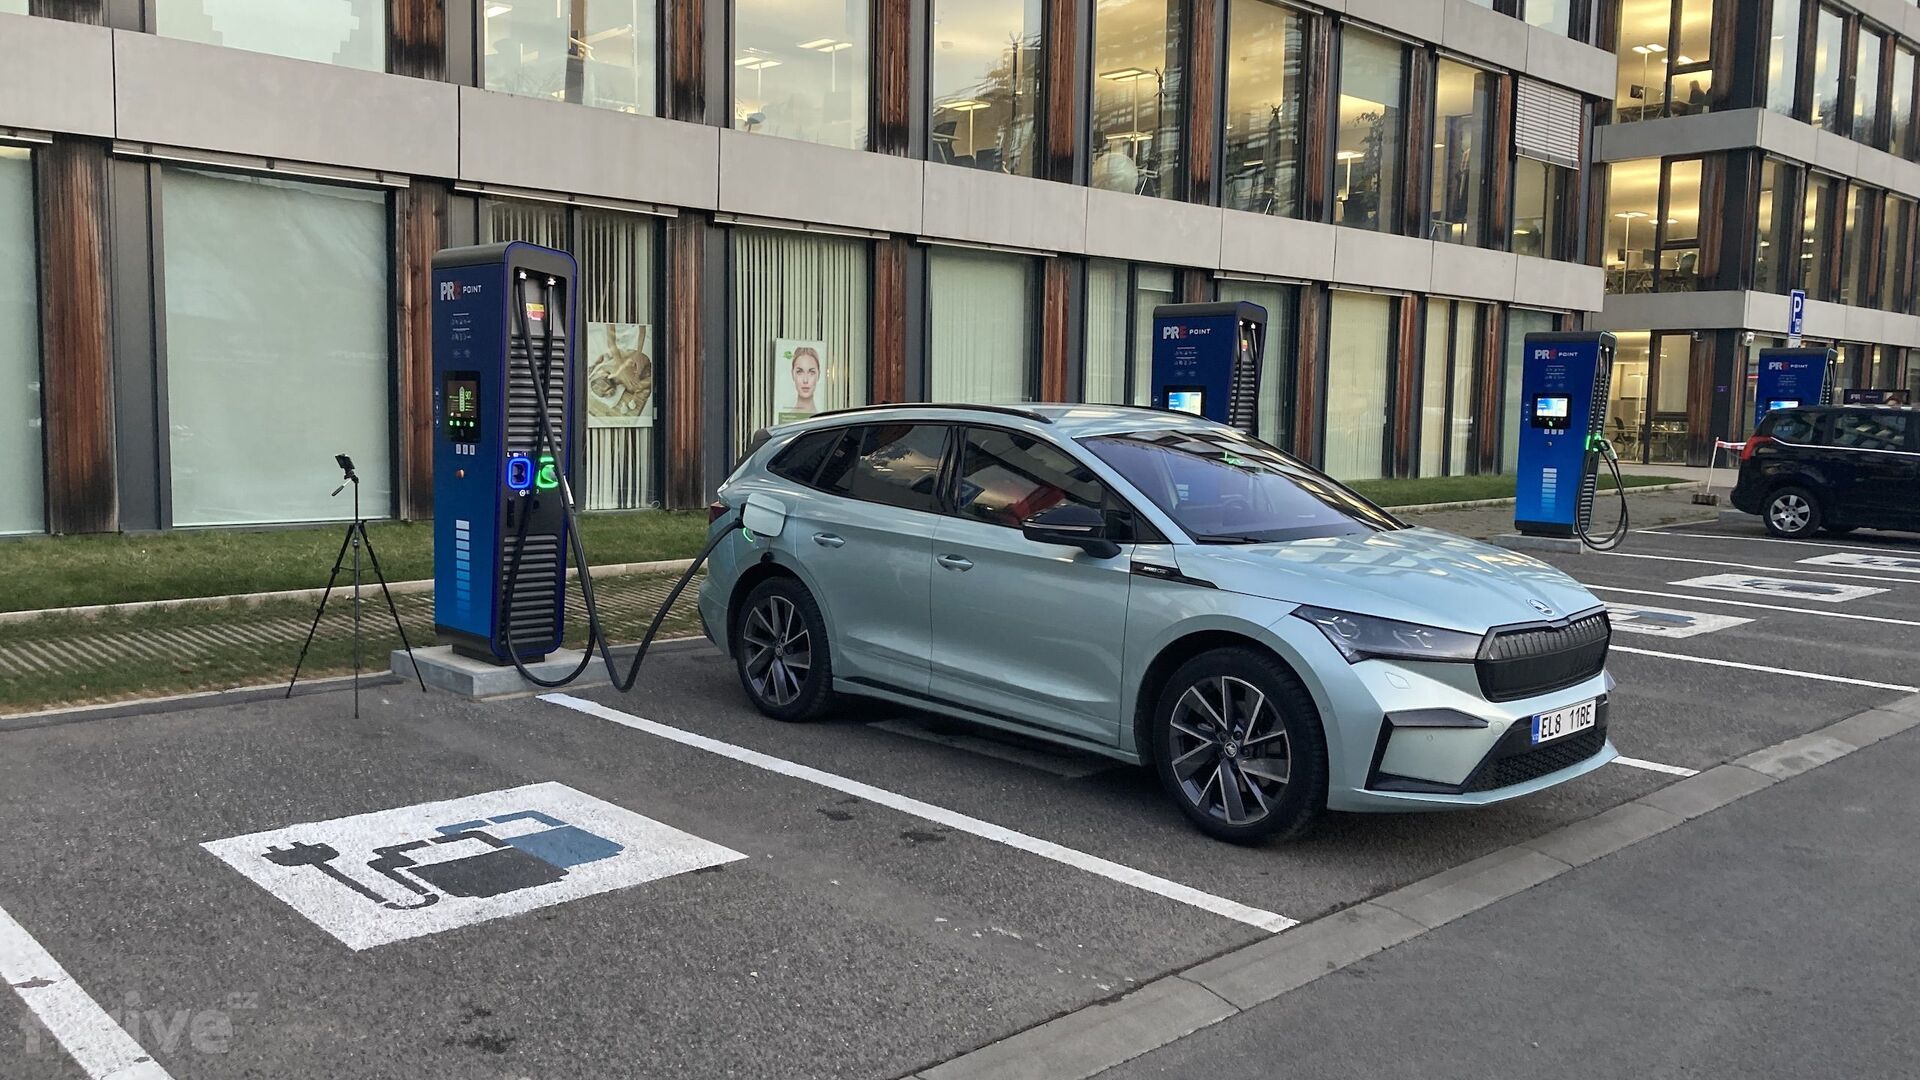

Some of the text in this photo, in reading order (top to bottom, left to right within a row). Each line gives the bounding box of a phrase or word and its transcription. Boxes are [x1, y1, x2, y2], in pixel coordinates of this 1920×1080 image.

[462, 285, 482, 294] POINT
[1792, 296, 1802, 322] P
[1541, 704, 1592, 738] EL8 11BE
